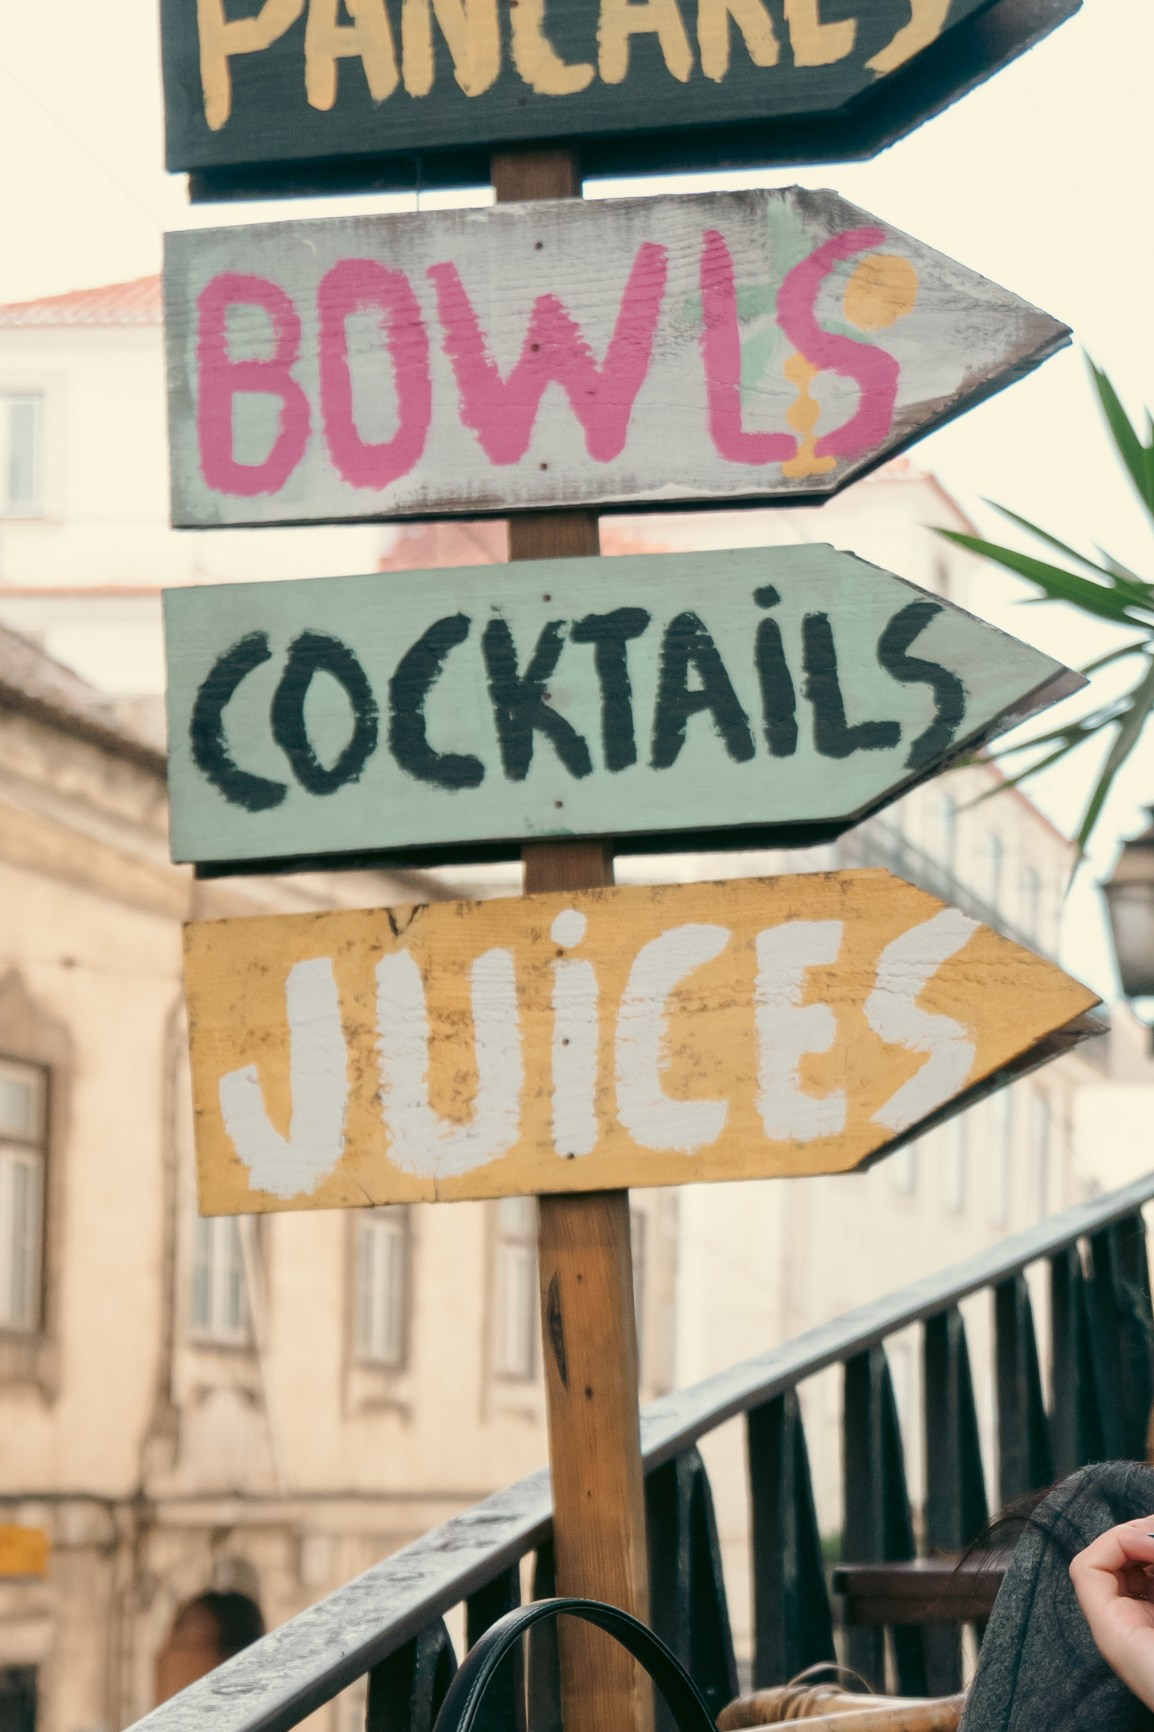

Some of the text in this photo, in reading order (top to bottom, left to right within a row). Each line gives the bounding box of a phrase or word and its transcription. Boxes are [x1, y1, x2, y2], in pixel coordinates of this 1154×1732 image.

[198, 228, 899, 496] BOWLS
[190, 584, 966, 812] COCKTAILS
[218, 909, 981, 1198] JUICES
